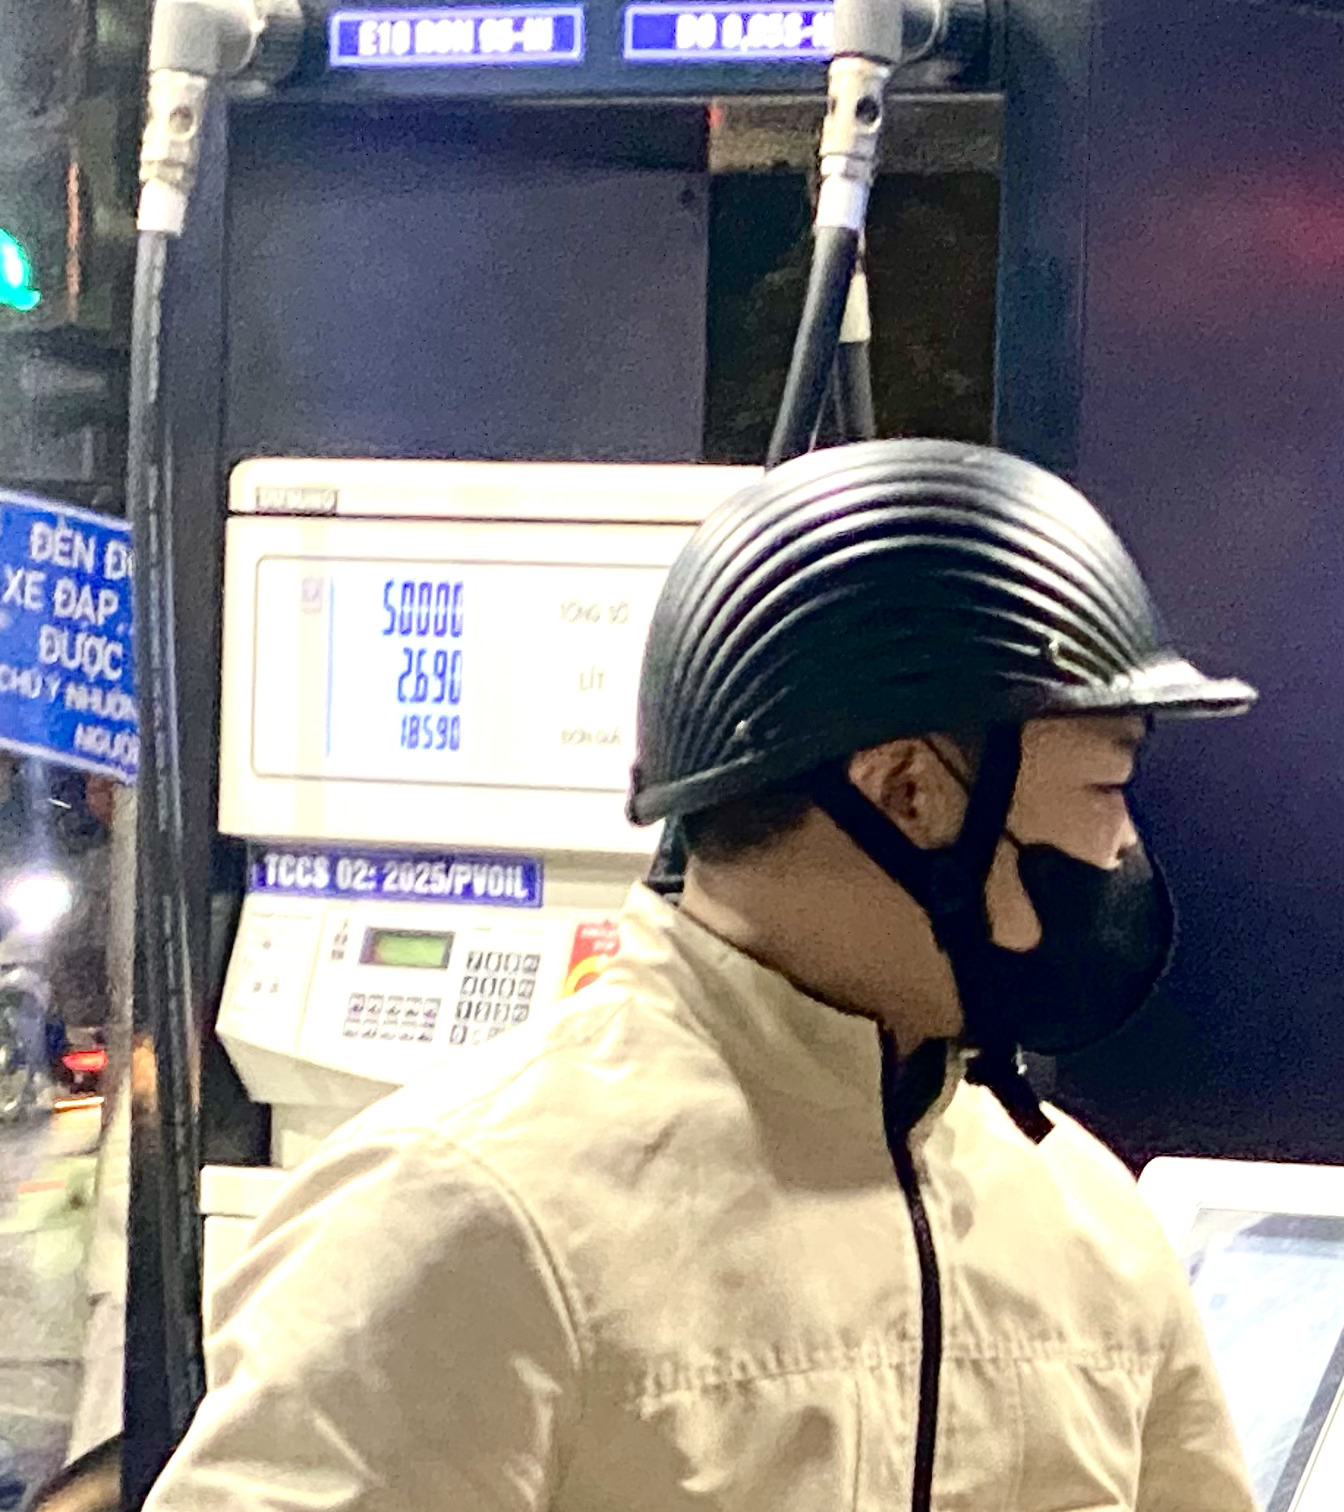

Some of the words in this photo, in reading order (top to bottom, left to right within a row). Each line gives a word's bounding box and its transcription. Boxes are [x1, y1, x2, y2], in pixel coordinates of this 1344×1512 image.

[30, 514, 96, 574] ĐÈN
[3, 564, 46, 612] XE
[381, 578, 464, 638] 50000
[399, 713, 462, 752] 18590
[263, 852, 331, 890] TCCS
[381, 860, 529, 900] 2025/PVOIL
